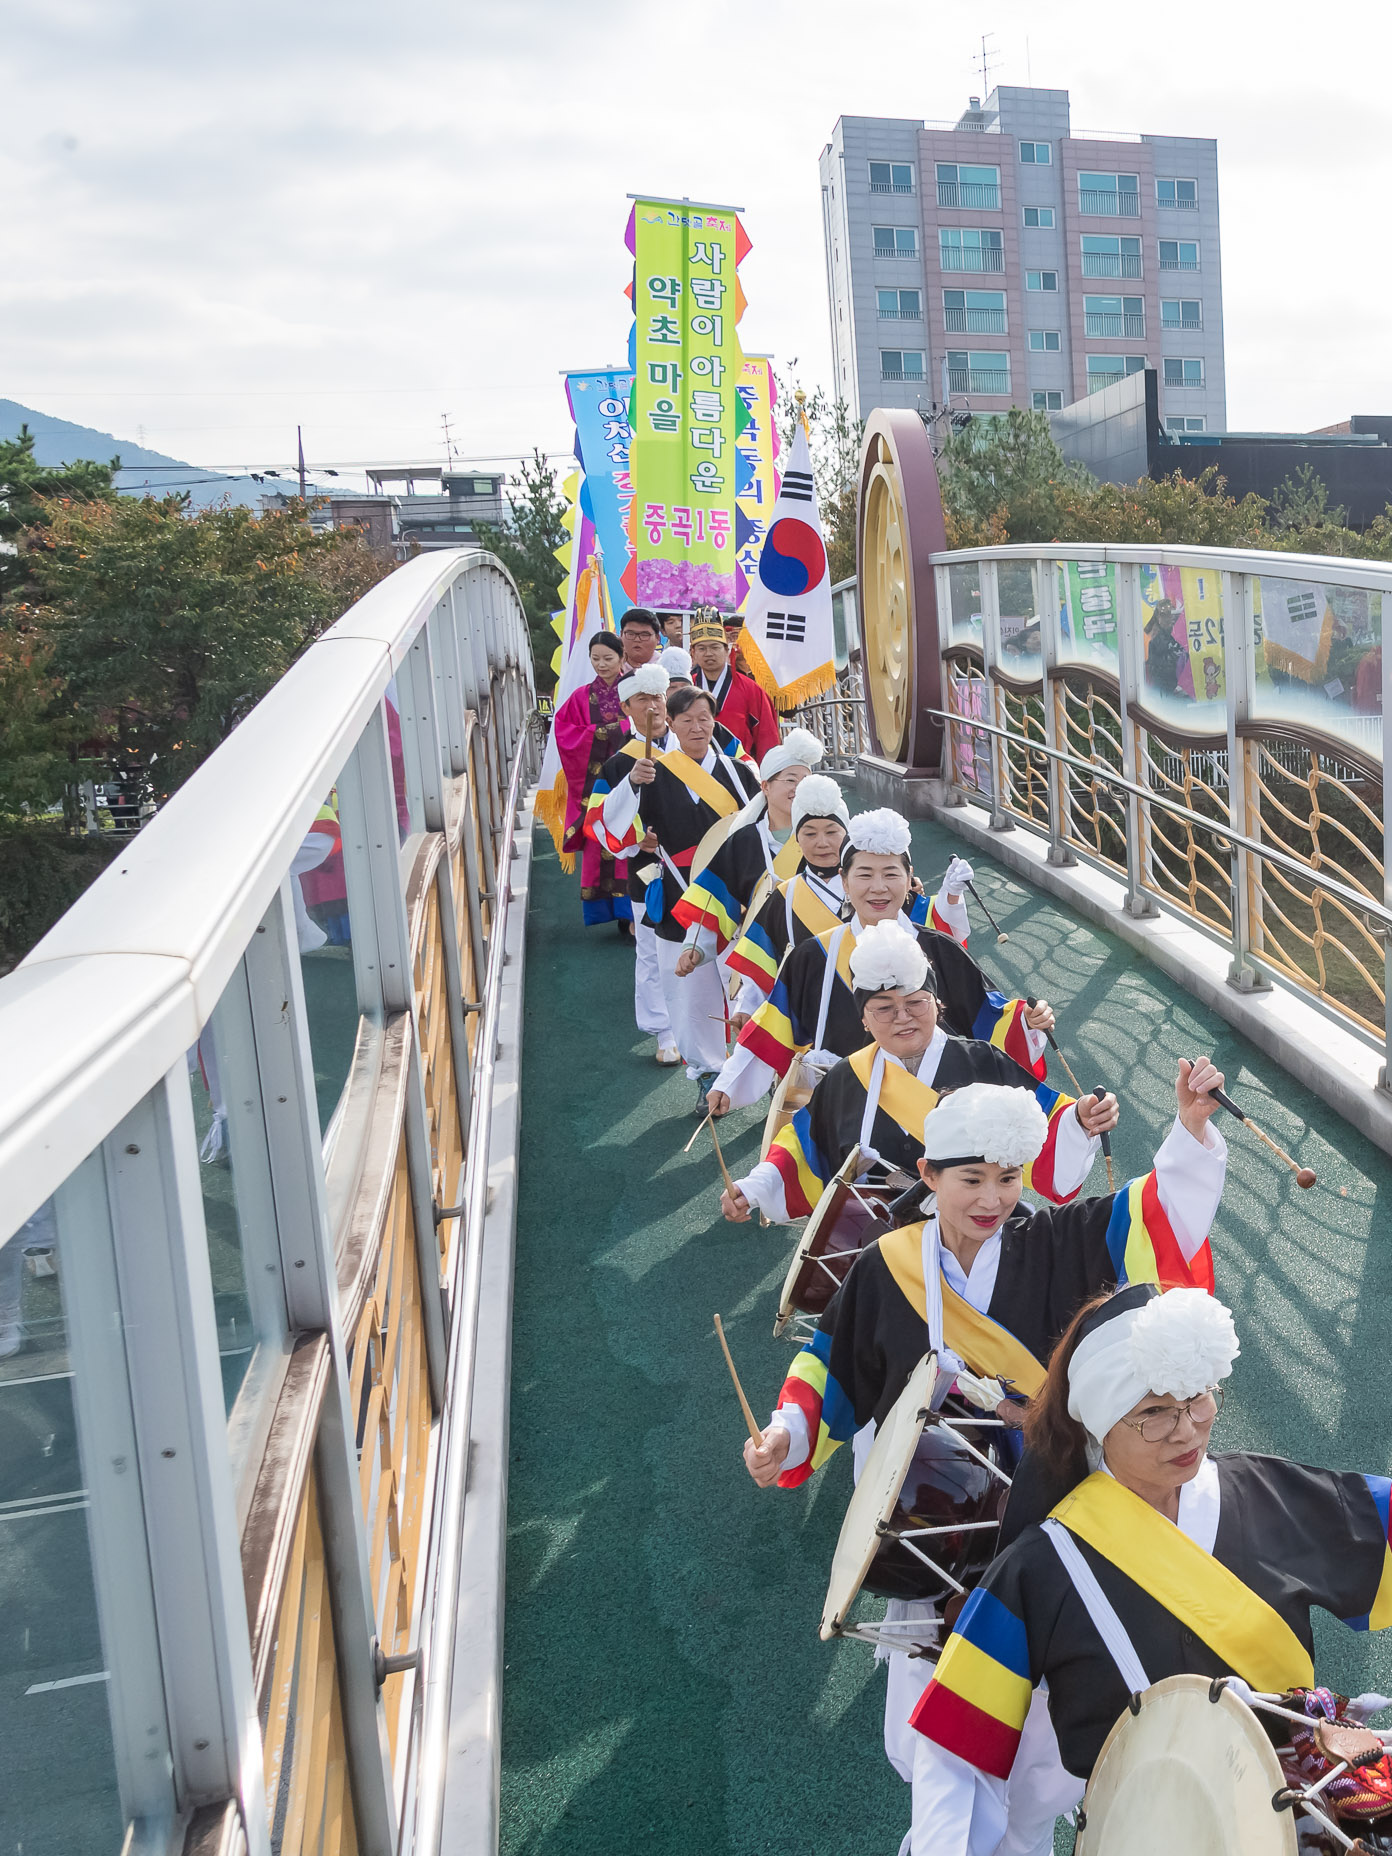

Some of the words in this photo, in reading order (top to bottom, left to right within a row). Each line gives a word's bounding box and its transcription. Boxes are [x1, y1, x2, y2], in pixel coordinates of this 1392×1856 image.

[706, 216, 731, 232] 축제
[647, 276, 682, 346] 약초
[689, 242, 726, 346] 사람이
[647, 361, 683, 433] 마을
[689, 356, 726, 493] 아름다운
[643, 503, 731, 550] 중곡1동
